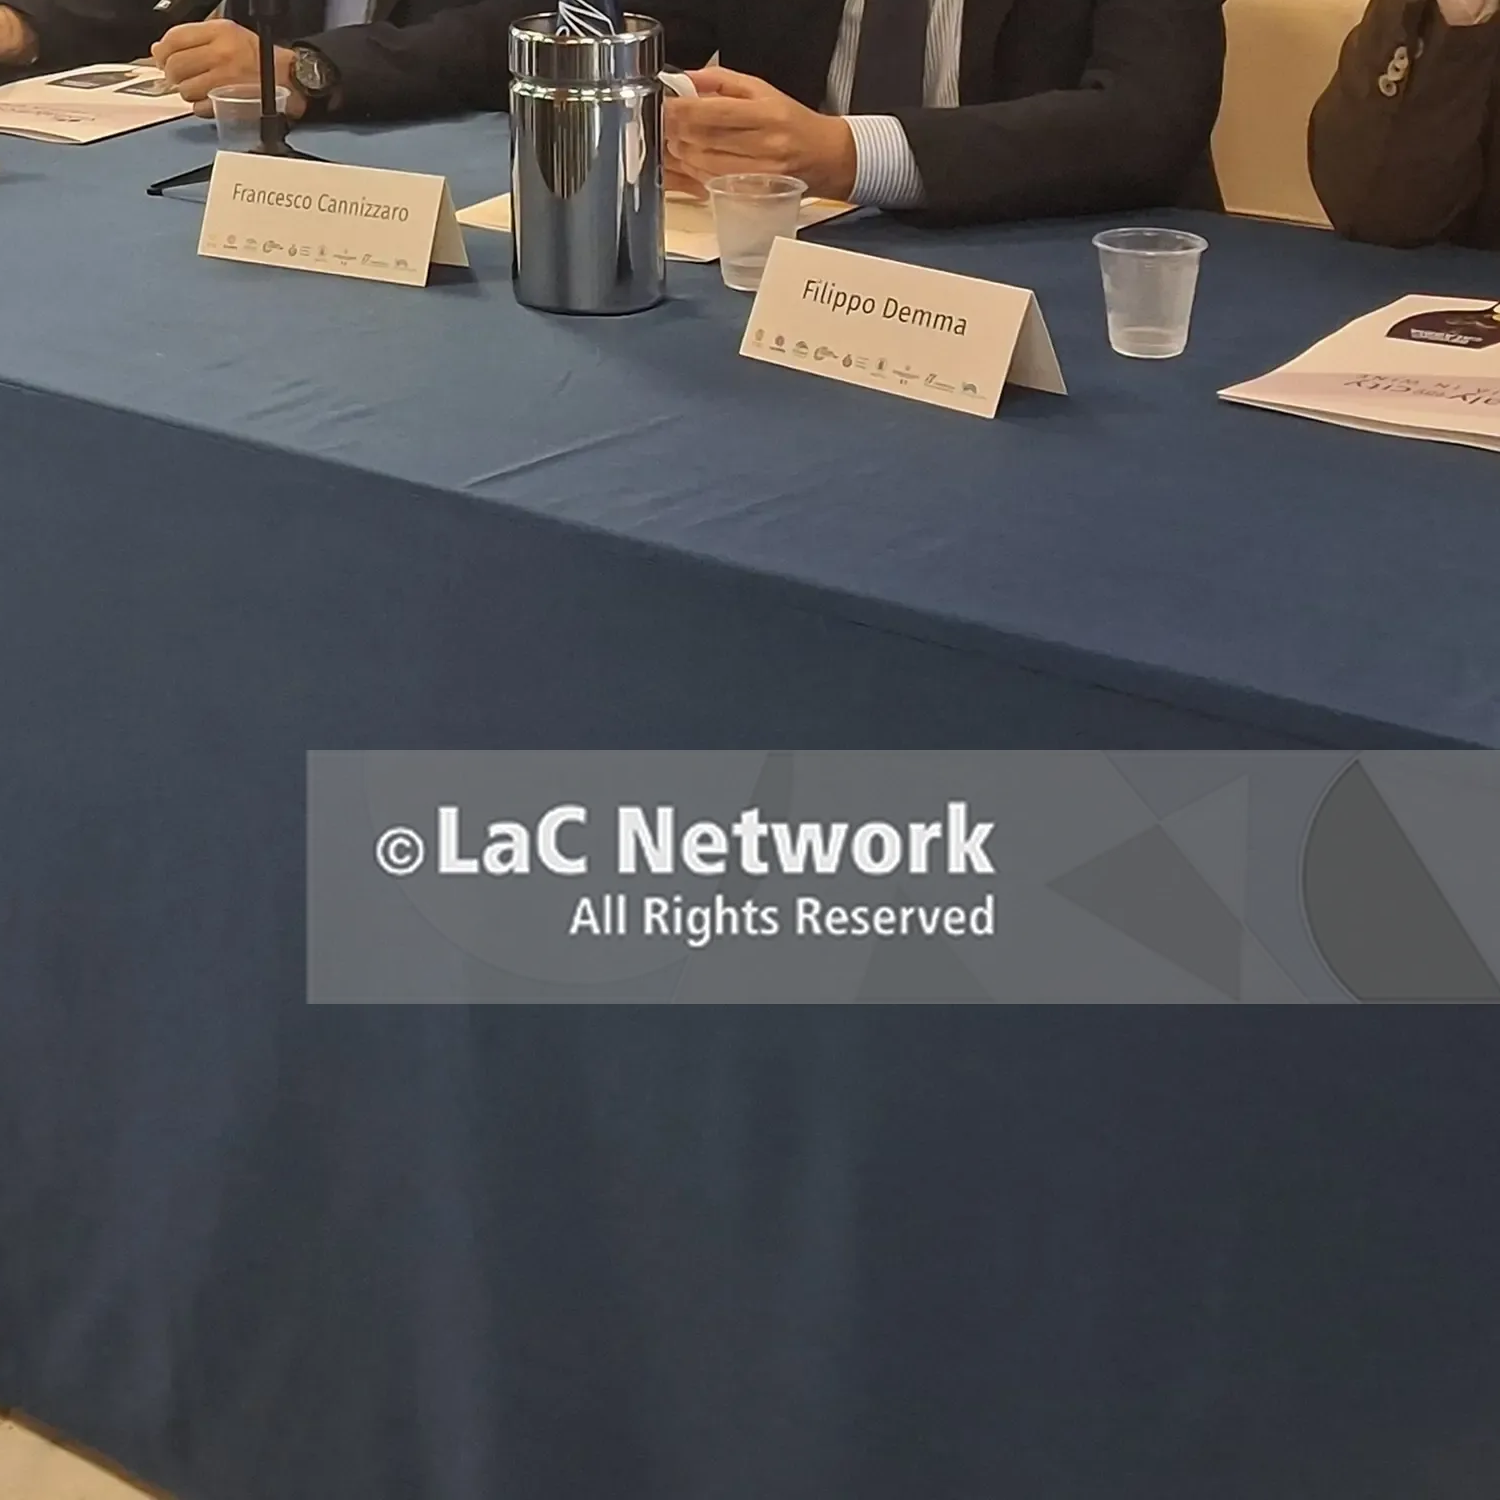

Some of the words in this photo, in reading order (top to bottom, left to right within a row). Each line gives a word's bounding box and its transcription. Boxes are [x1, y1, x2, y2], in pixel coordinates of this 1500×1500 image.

[232, 183, 312, 210] Francesco
[317, 193, 409, 222] Cannizzaro
[802, 279, 876, 316] Filippo
[882, 297, 968, 336] Demma
